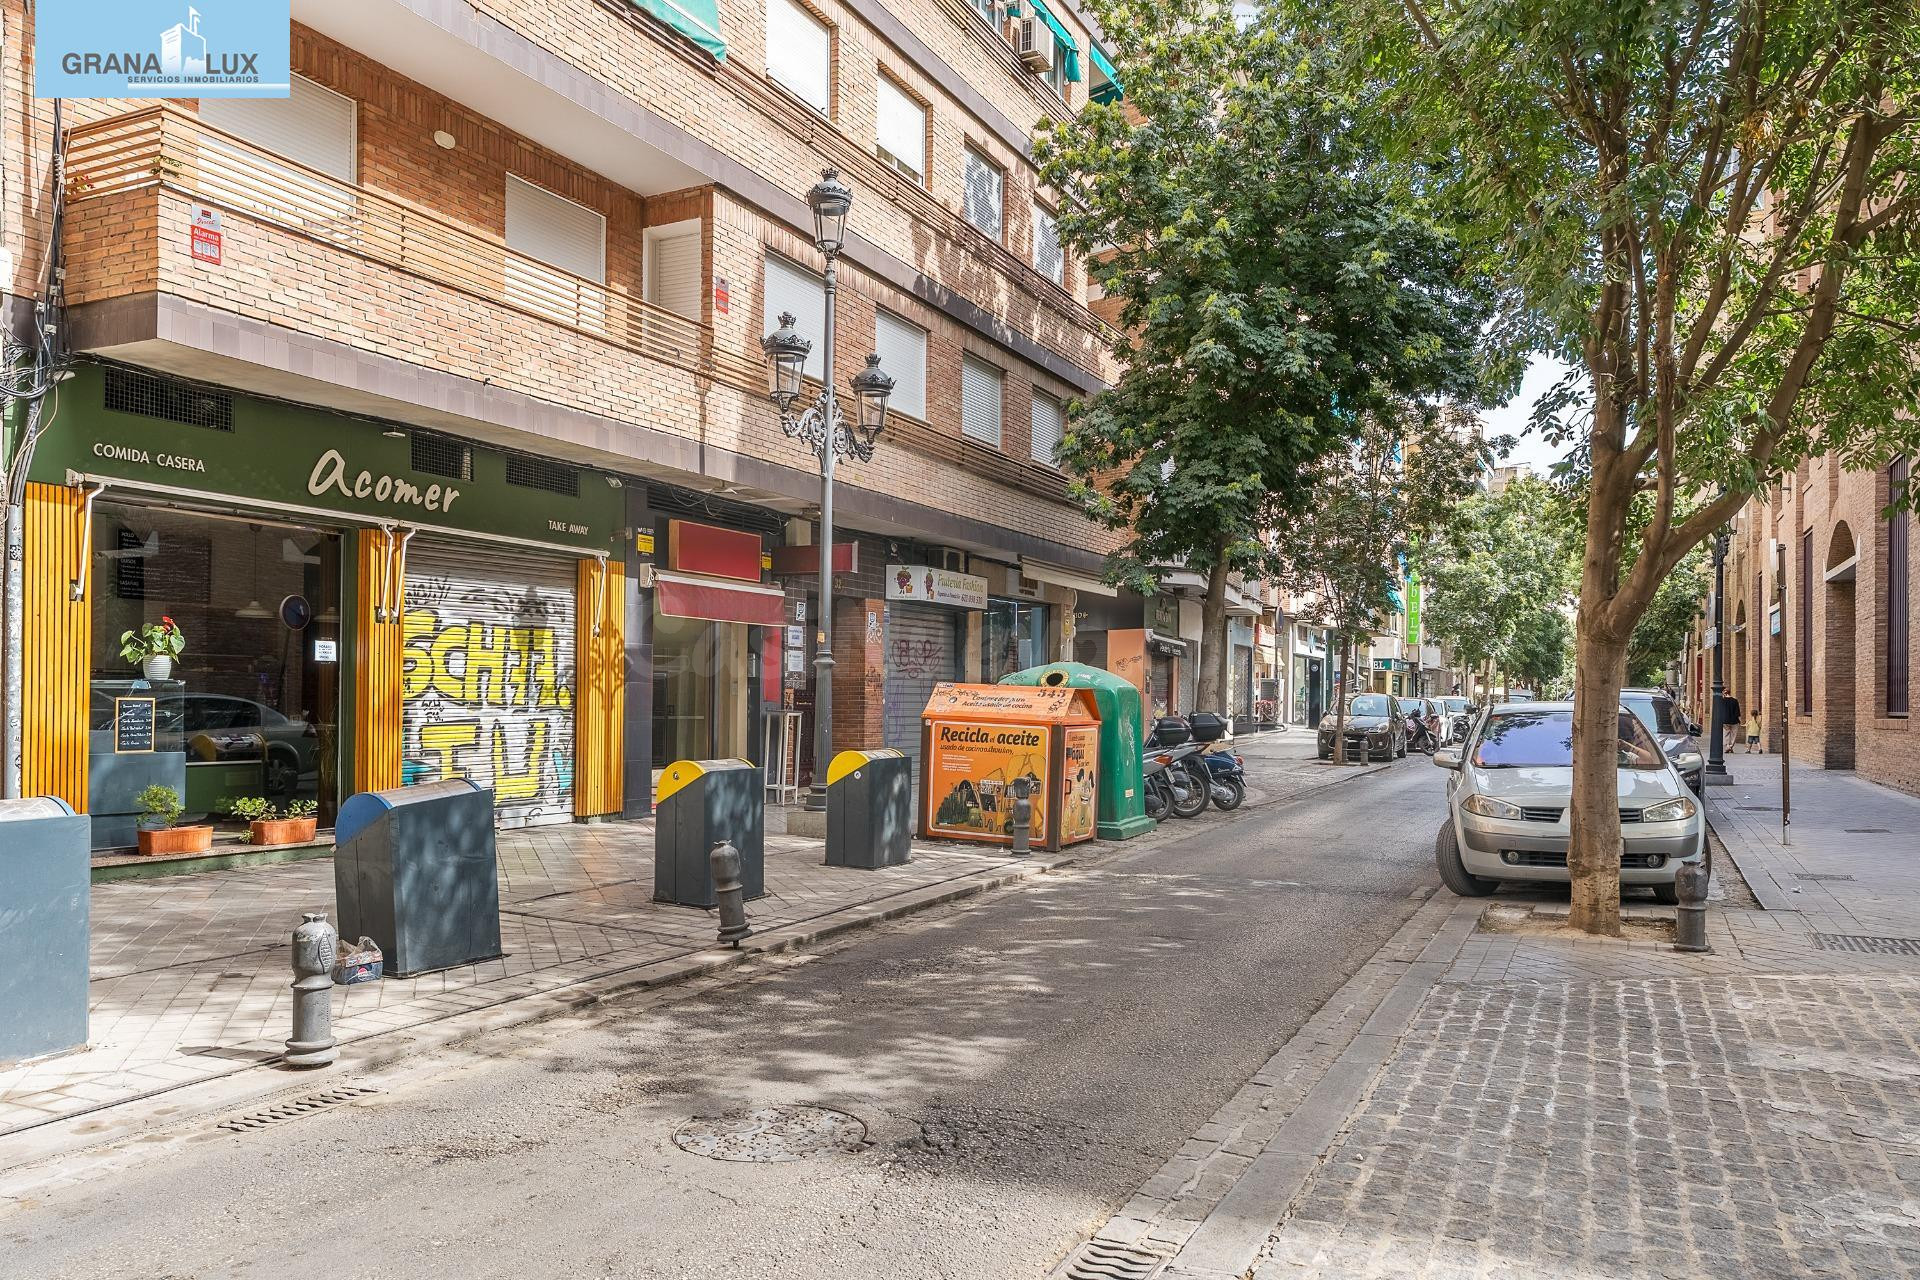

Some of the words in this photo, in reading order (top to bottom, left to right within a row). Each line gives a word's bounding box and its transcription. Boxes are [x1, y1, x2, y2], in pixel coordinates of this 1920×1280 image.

[194, 228, 219, 241] Alarma
[93, 443, 150, 464] COMIDA
[156, 453, 205, 473] CASERA
[548, 519, 567, 531] TAKE
[568, 523, 589, 535] AWAY
[941, 727, 989, 743] Recicla
[997, 730, 1039, 746] aceite
